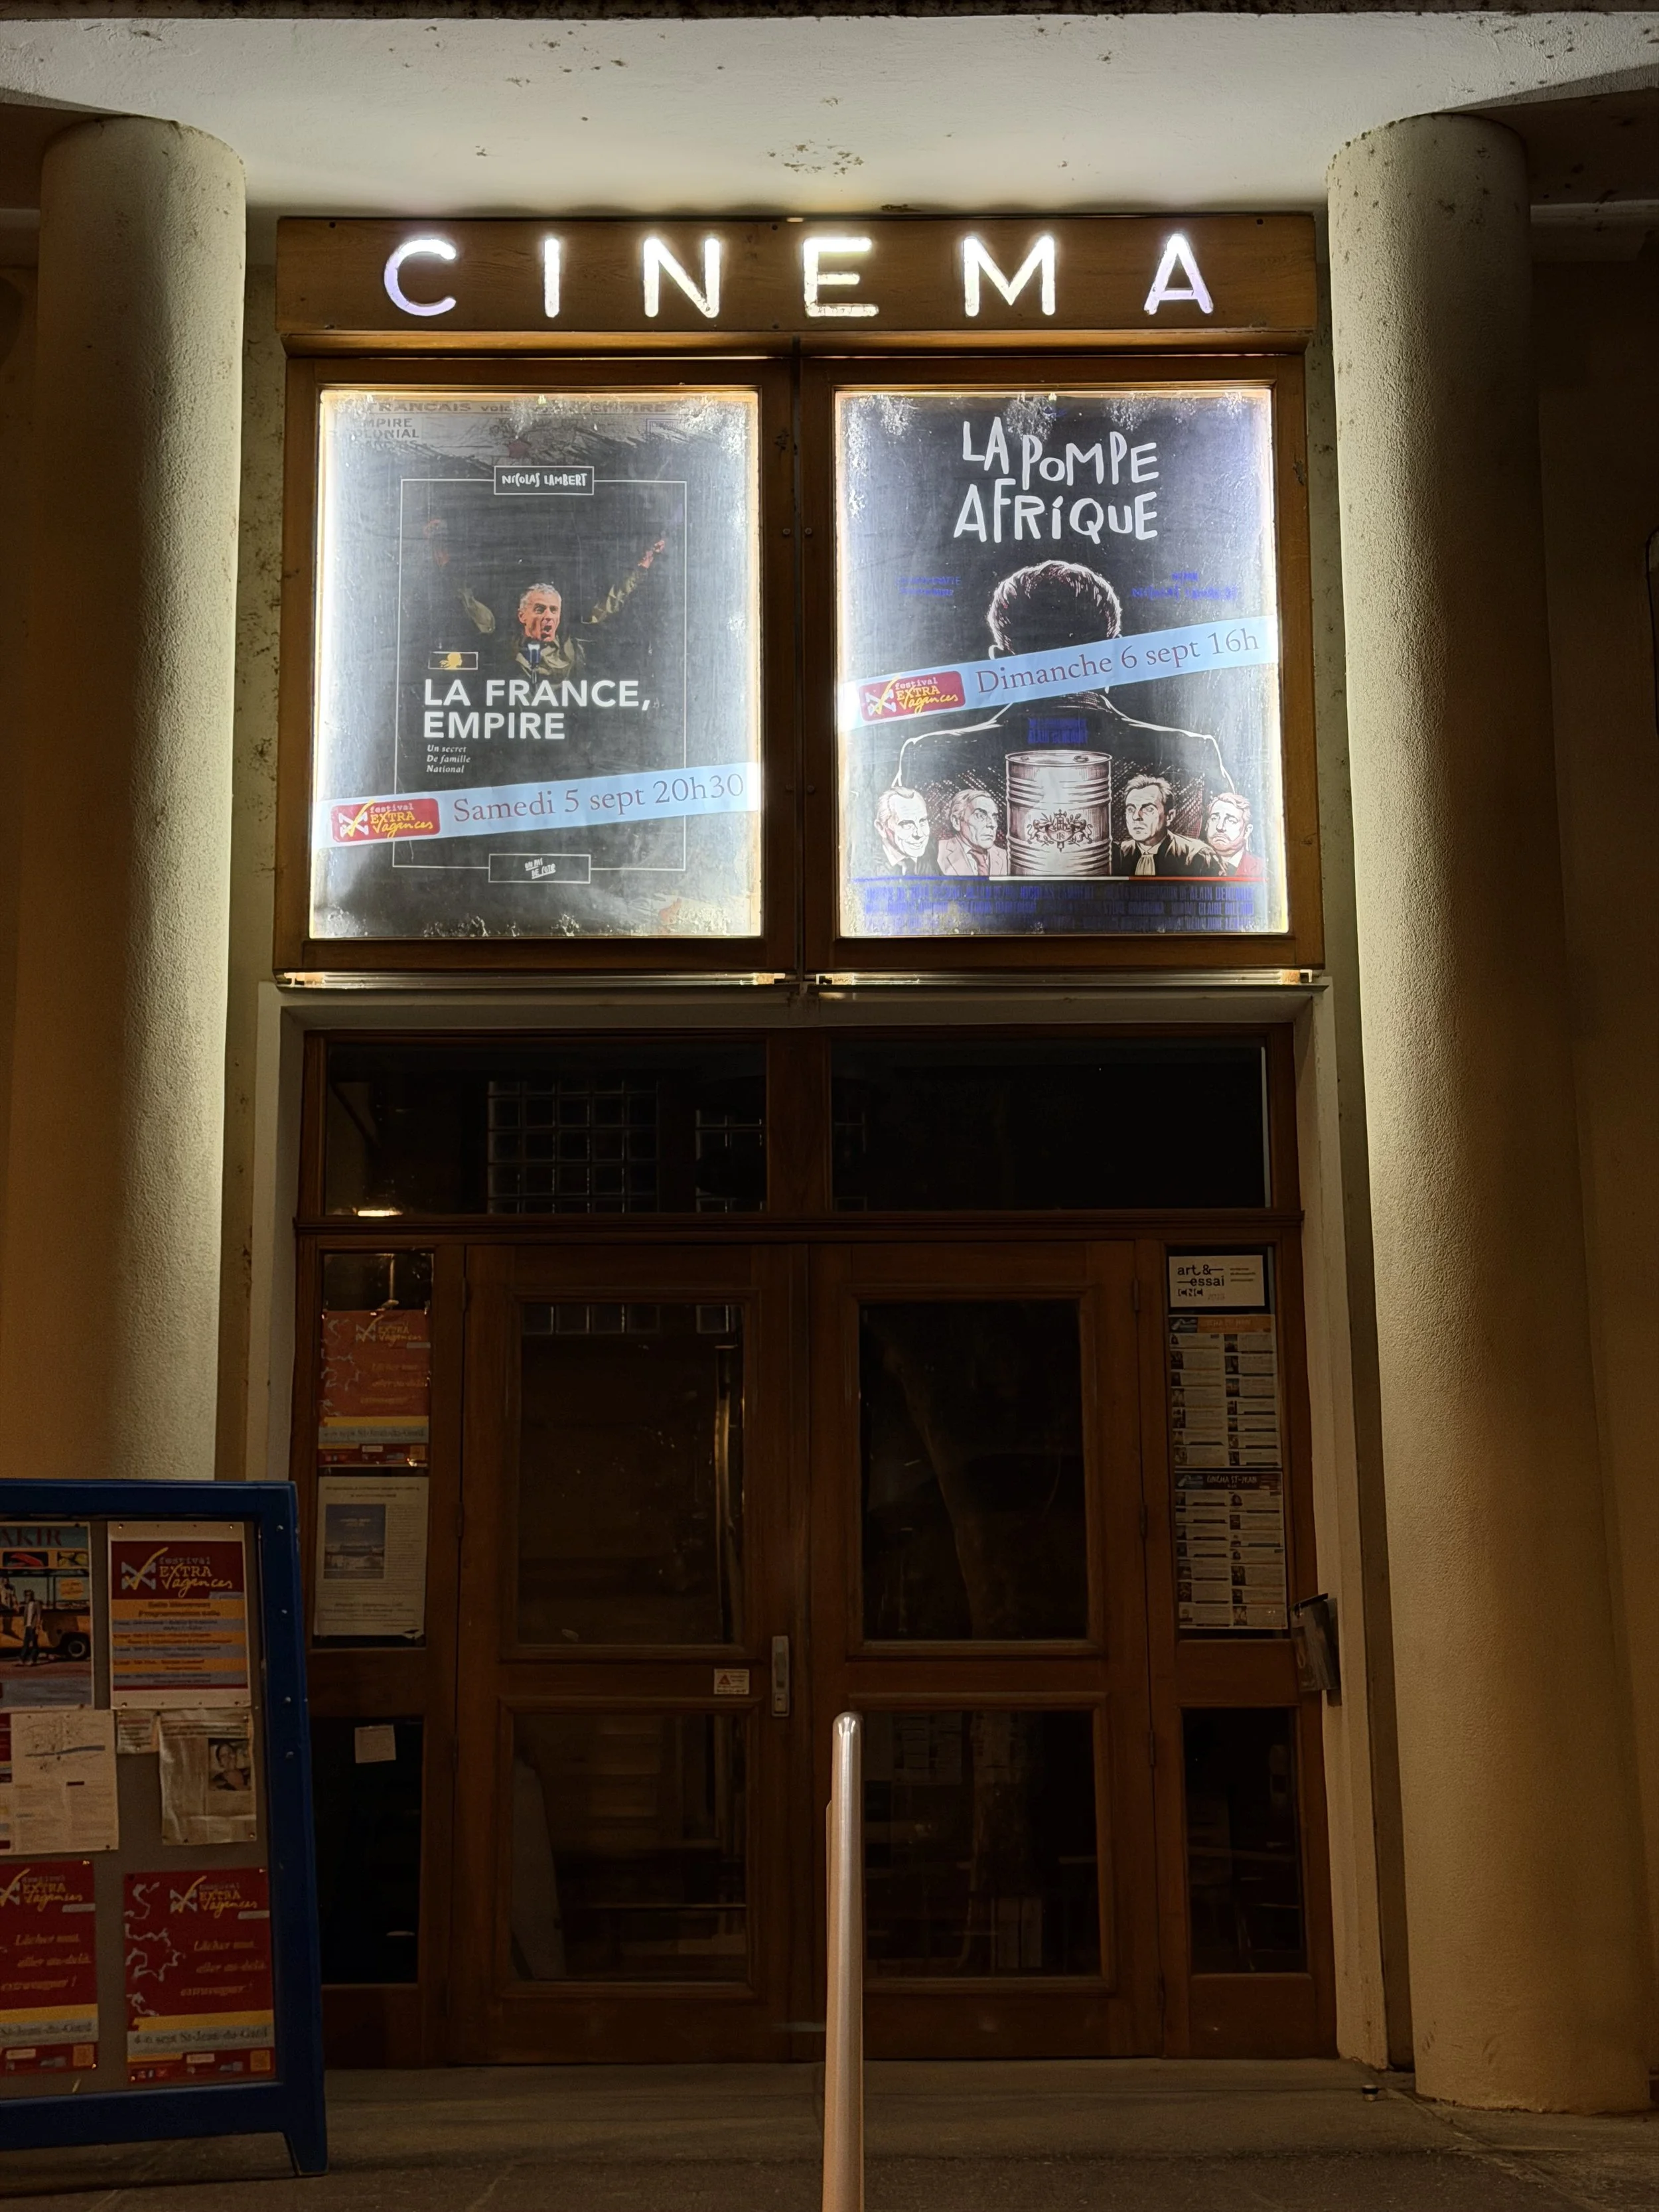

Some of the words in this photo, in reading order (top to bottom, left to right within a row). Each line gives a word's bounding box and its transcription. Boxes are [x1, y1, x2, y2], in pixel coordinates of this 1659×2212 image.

[384, 235, 1214, 317] CINEMA
[962, 417, 1009, 473] LA
[1023, 431, 1159, 490] POMPE
[502, 472, 540, 487] NICOLAS
[544, 473, 587, 486] LAMBERT
[953, 478, 1158, 544] AFRIQUE
[975, 654, 1113, 693] Dimanche
[1121, 645, 1137, 669] 6
[1146, 642, 1200, 669] sept
[1207, 628, 1260, 654] 16h
[895, 677, 938, 690] festival
[424, 679, 471, 706] LA
[486, 679, 651, 711] FRANCE,
[896, 686, 940, 700] EXTRA
[424, 711, 565, 739] EMPIRE
[439, 755, 470, 764] famille
[453, 792, 555, 822] Samedi
[564, 788, 579, 812] 5
[590, 788, 644, 815] sept
[653, 773, 744, 804] 20h30
[370, 803, 414, 814] festival
[370, 811, 415, 824] EXTRA
[1177, 1264, 1200, 1276] art
[1190, 1276, 1224, 1286] essai
[159, 1566, 213, 1578] EXTRA
